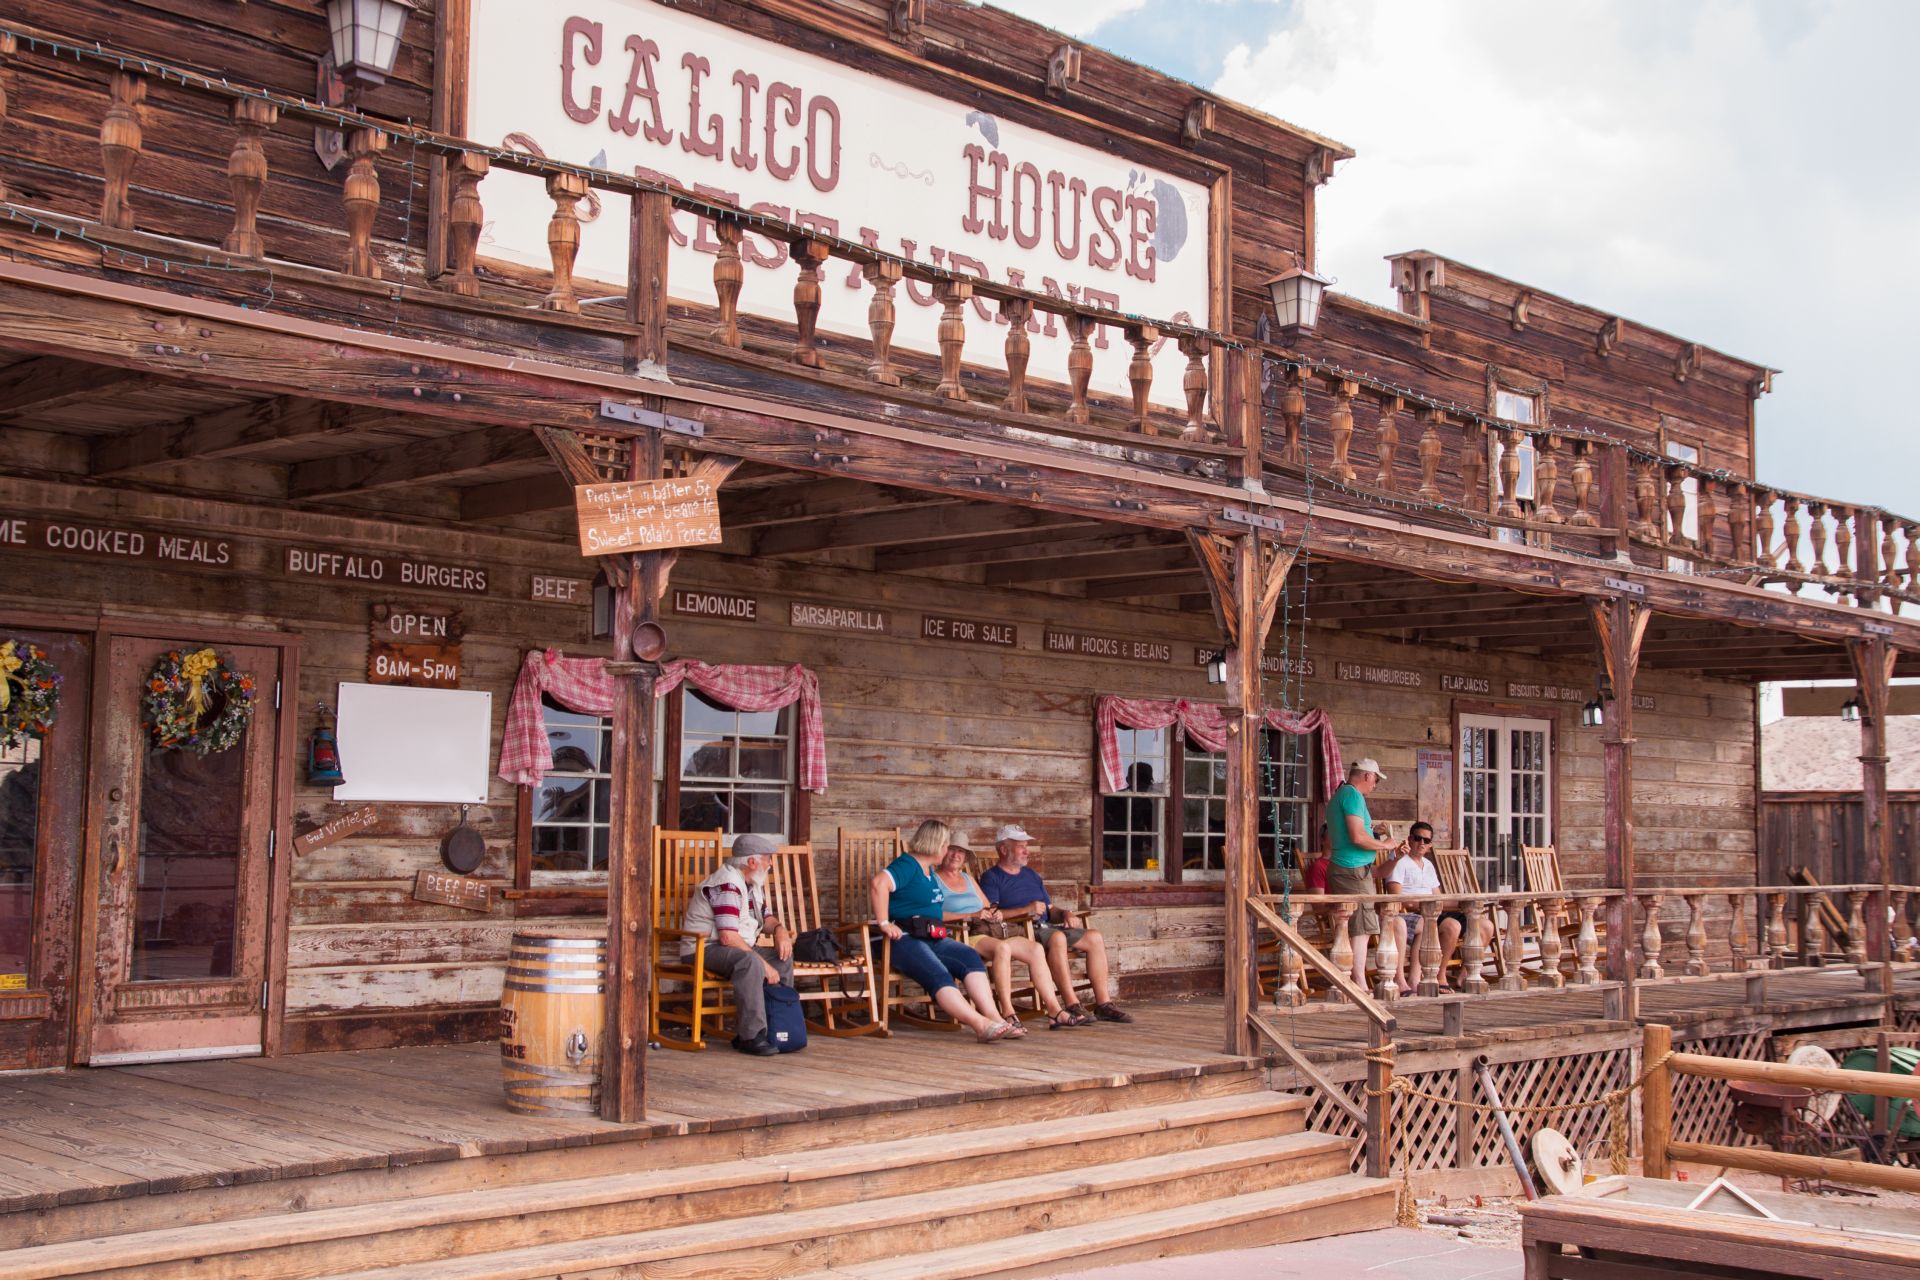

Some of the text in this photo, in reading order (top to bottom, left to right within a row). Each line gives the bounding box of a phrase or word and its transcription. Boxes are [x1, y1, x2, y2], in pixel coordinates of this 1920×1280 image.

[560, 16, 1156, 283] CALICO HOUSE
[47, 525, 145, 556] COOKED
[158, 536, 230, 564] MEALS
[588, 526, 634, 550] Sweet
[288, 549, 487, 591] BUFFALO BURGERS
[533, 577, 577, 600] BEEF
[676, 591, 756, 618] LEMONADE
[390, 614, 446, 637] OPEN
[793, 605, 884, 632] SARSAPARILLA
[924, 619, 1013, 644] ICE FOR SALE
[1049, 633, 1075, 651] HAM
[1082, 636, 1118, 656] HOCKS
[1134, 642, 1170, 662] BEANS
[376, 655, 457, 681] 8AM-5PM
[1365, 667, 1421, 687] HAMBURGERS
[1443, 675, 1489, 693] FLAPJACKS
[1510, 683, 1582, 702] BISCUITS AND GRAVY
